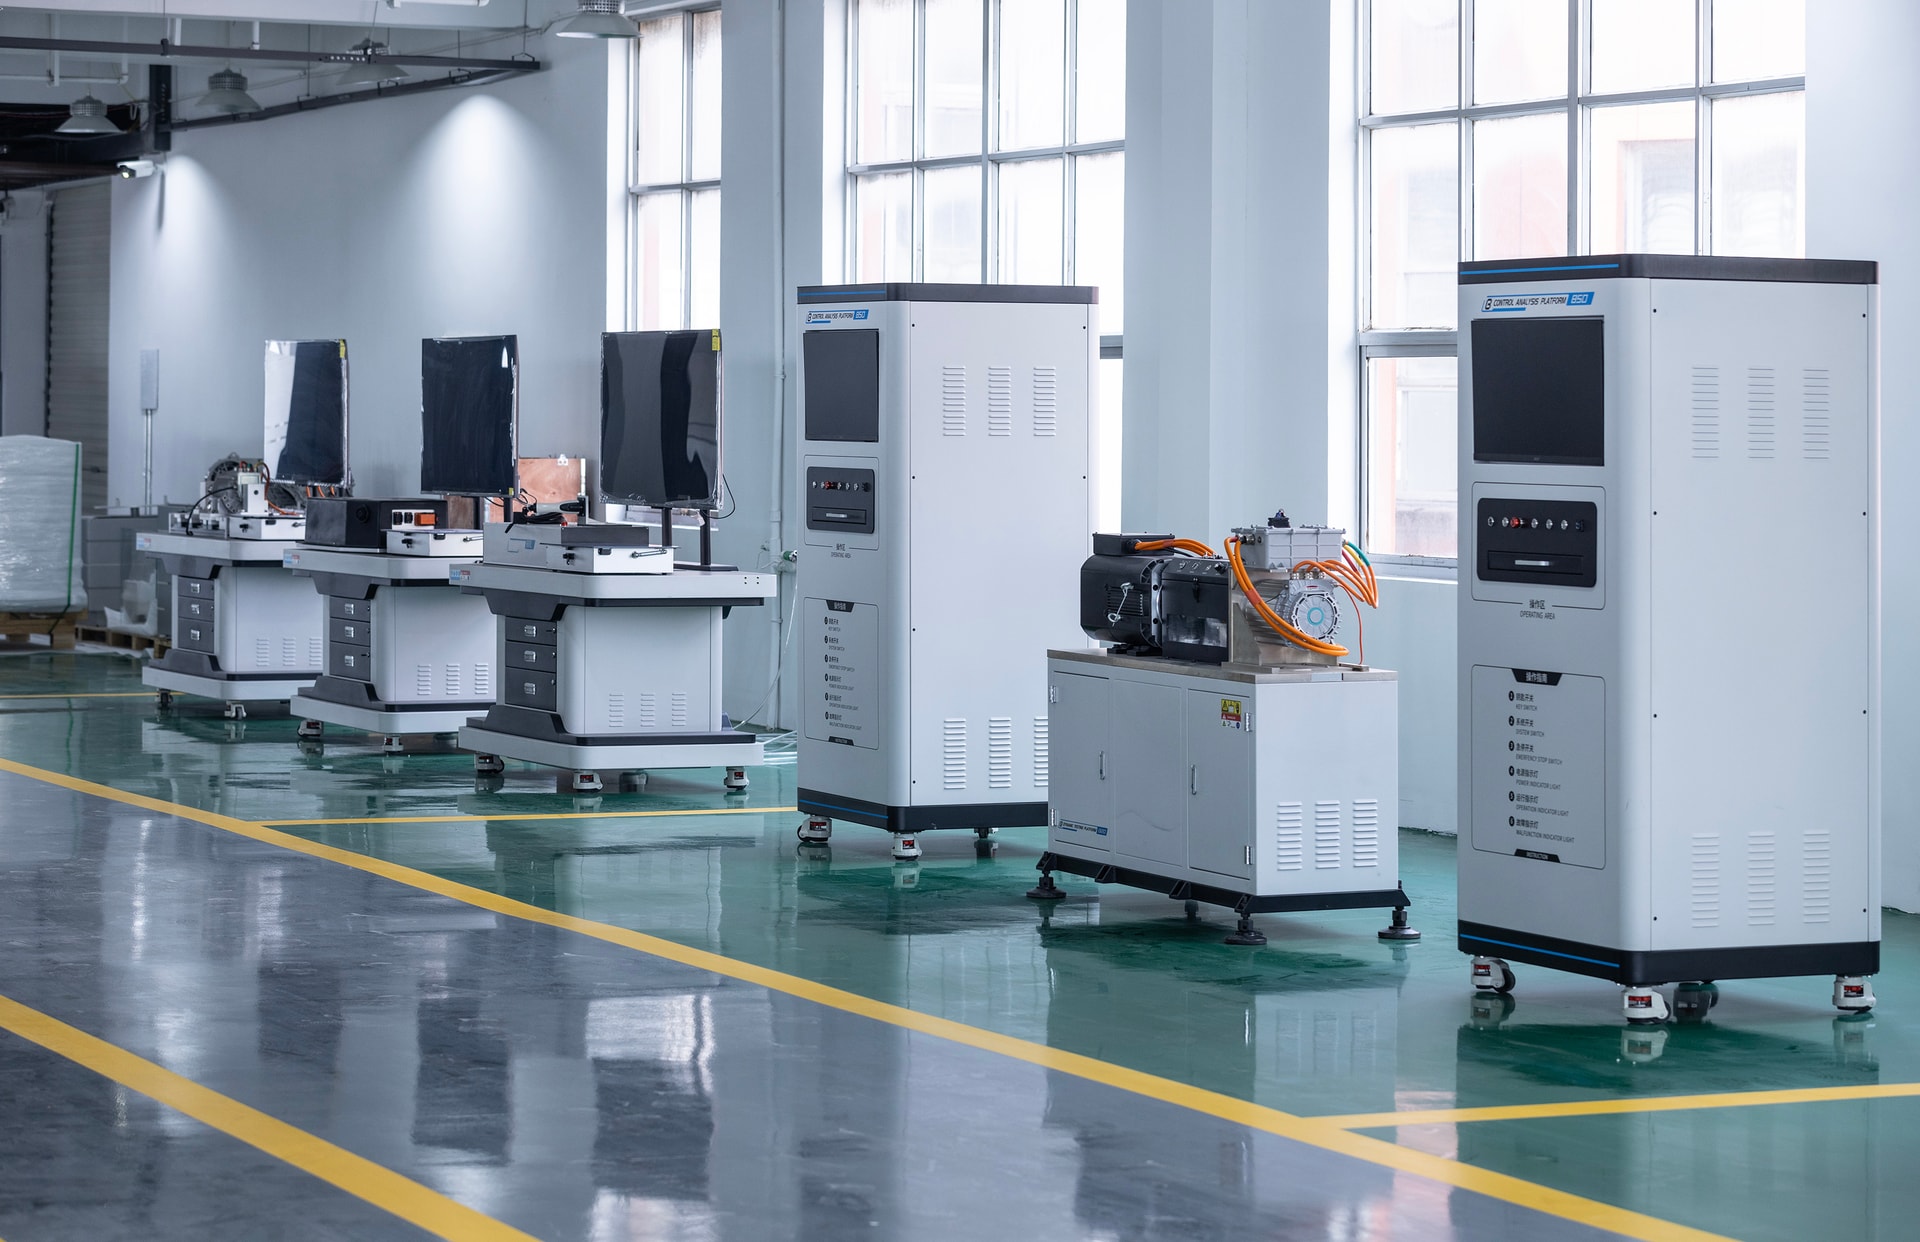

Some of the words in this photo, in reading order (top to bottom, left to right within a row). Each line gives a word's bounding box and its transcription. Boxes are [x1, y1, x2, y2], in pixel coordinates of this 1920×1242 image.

[1493, 299, 1514, 307] CONTROL
[1515, 298, 1539, 306] ANALYSIS
[1540, 296, 1566, 305] PLATFORM
[1529, 599, 1545, 609] 操作区
[1519, 610, 1543, 619] OPERATING
[1544, 612, 1556, 620] AREA
[1530, 781, 1549, 789] INDICATOR
[1516, 804, 1537, 812] OPERATION
[1537, 807, 1557, 815] INDICATOR
[1557, 809, 1569, 817] LIGHT
[1516, 829, 1542, 838] MALFUNCTION
[1542, 833, 1562, 841] INDICATOR
[1562, 835, 1575, 843] LIGHT
